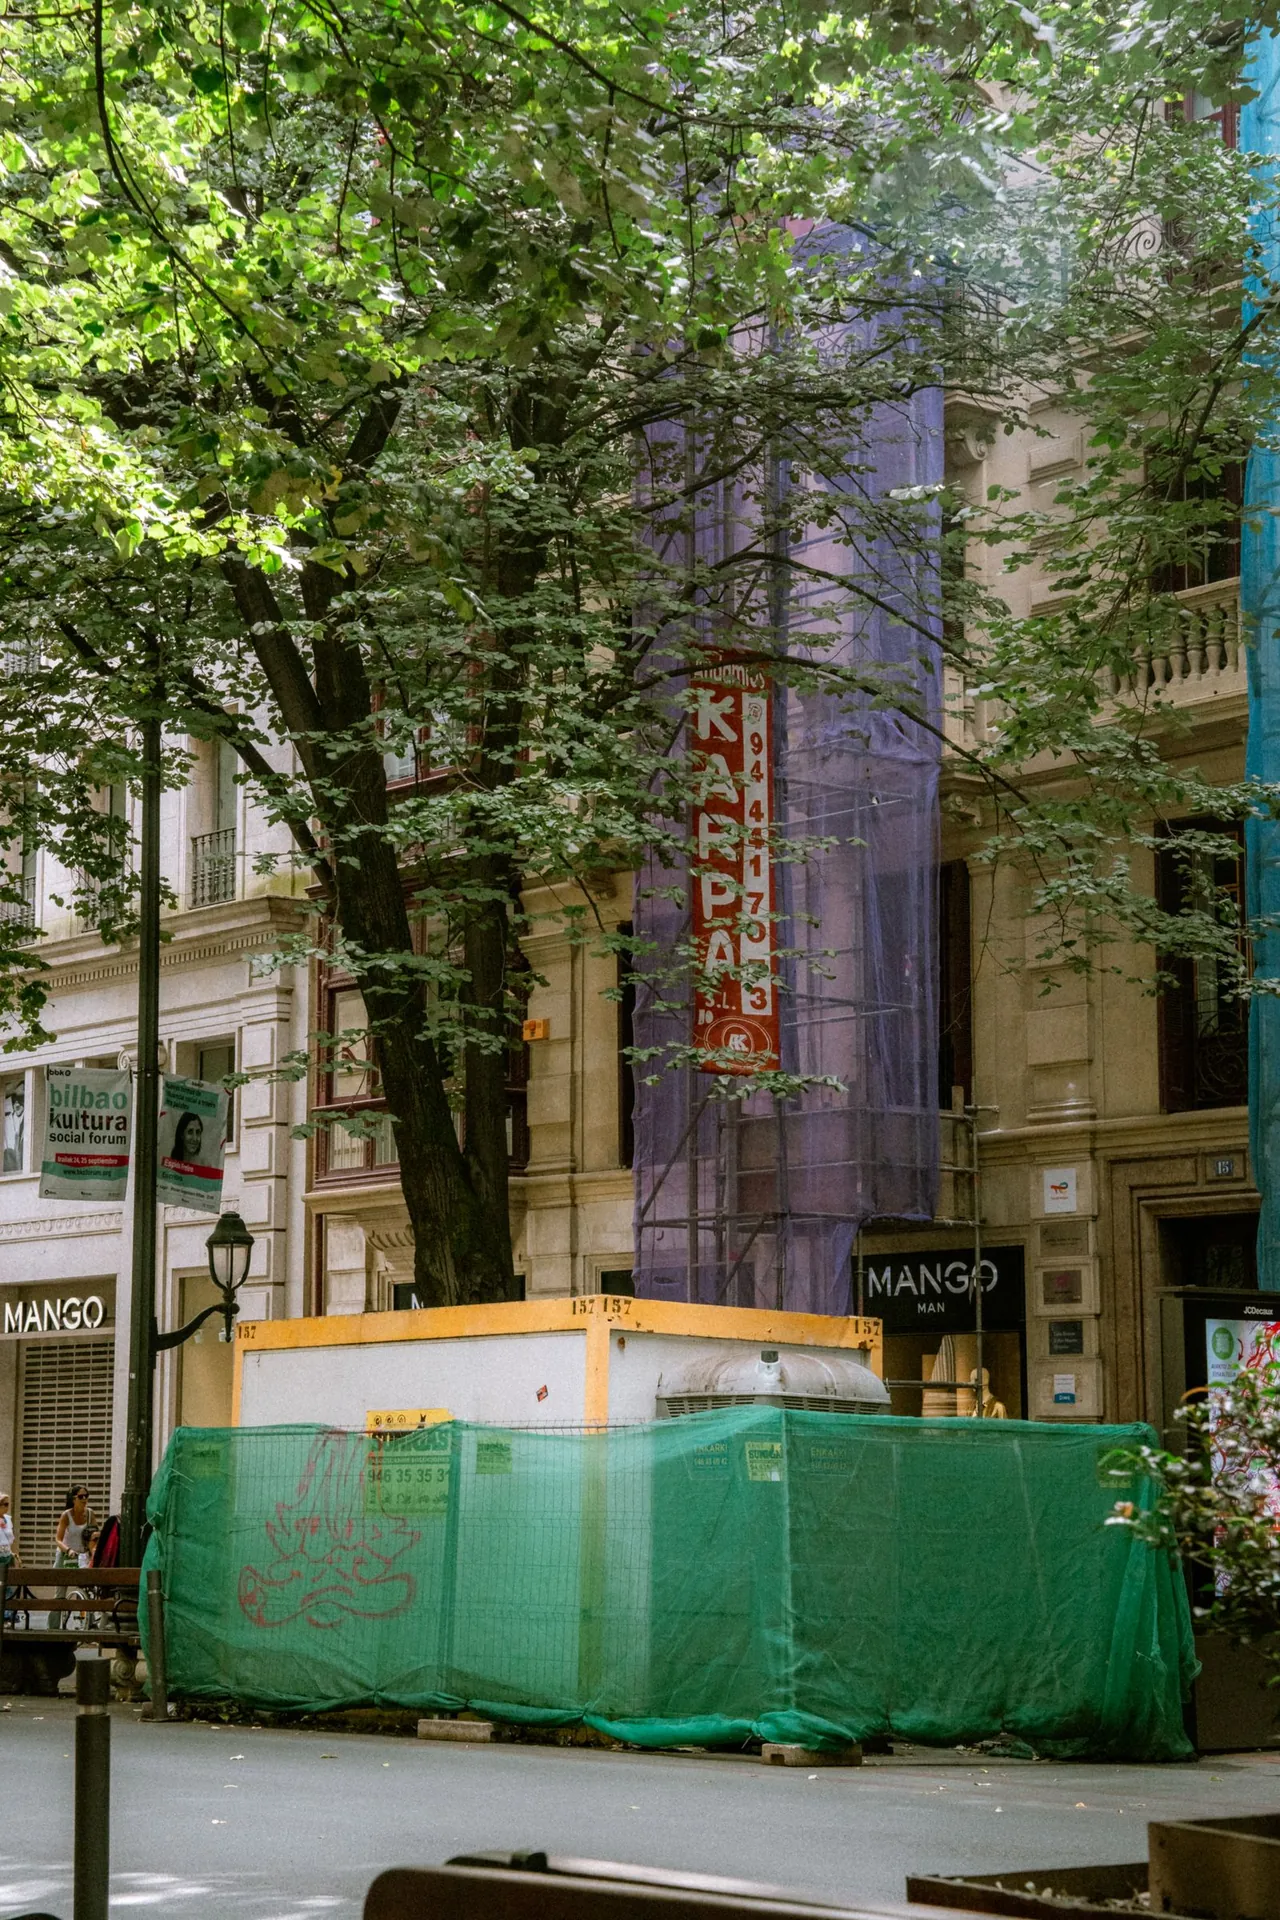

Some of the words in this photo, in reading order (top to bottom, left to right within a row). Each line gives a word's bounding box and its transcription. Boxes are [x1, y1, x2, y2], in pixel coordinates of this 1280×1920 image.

[697, 690, 738, 981] KARPA
[50, 1083, 128, 1110] bilbao
[49, 1107, 128, 1132] kultura
[49, 1132, 85, 1144] social
[88, 1132, 127, 1145] forum
[868, 1259, 998, 1298] MANGO
[572, 1299, 596, 1315] 157
[603, 1296, 632, 1315] 157
[917, 1301, 945, 1314] MAN
[1243, 1306, 1274, 1316] JCDecaux
[5, 1295, 104, 1334] MANGO
[238, 1325, 256, 1339] 157
[855, 1319, 880, 1336] 157
[396, 1467, 412, 1483] 35
[416, 1467, 432, 1483] 35
